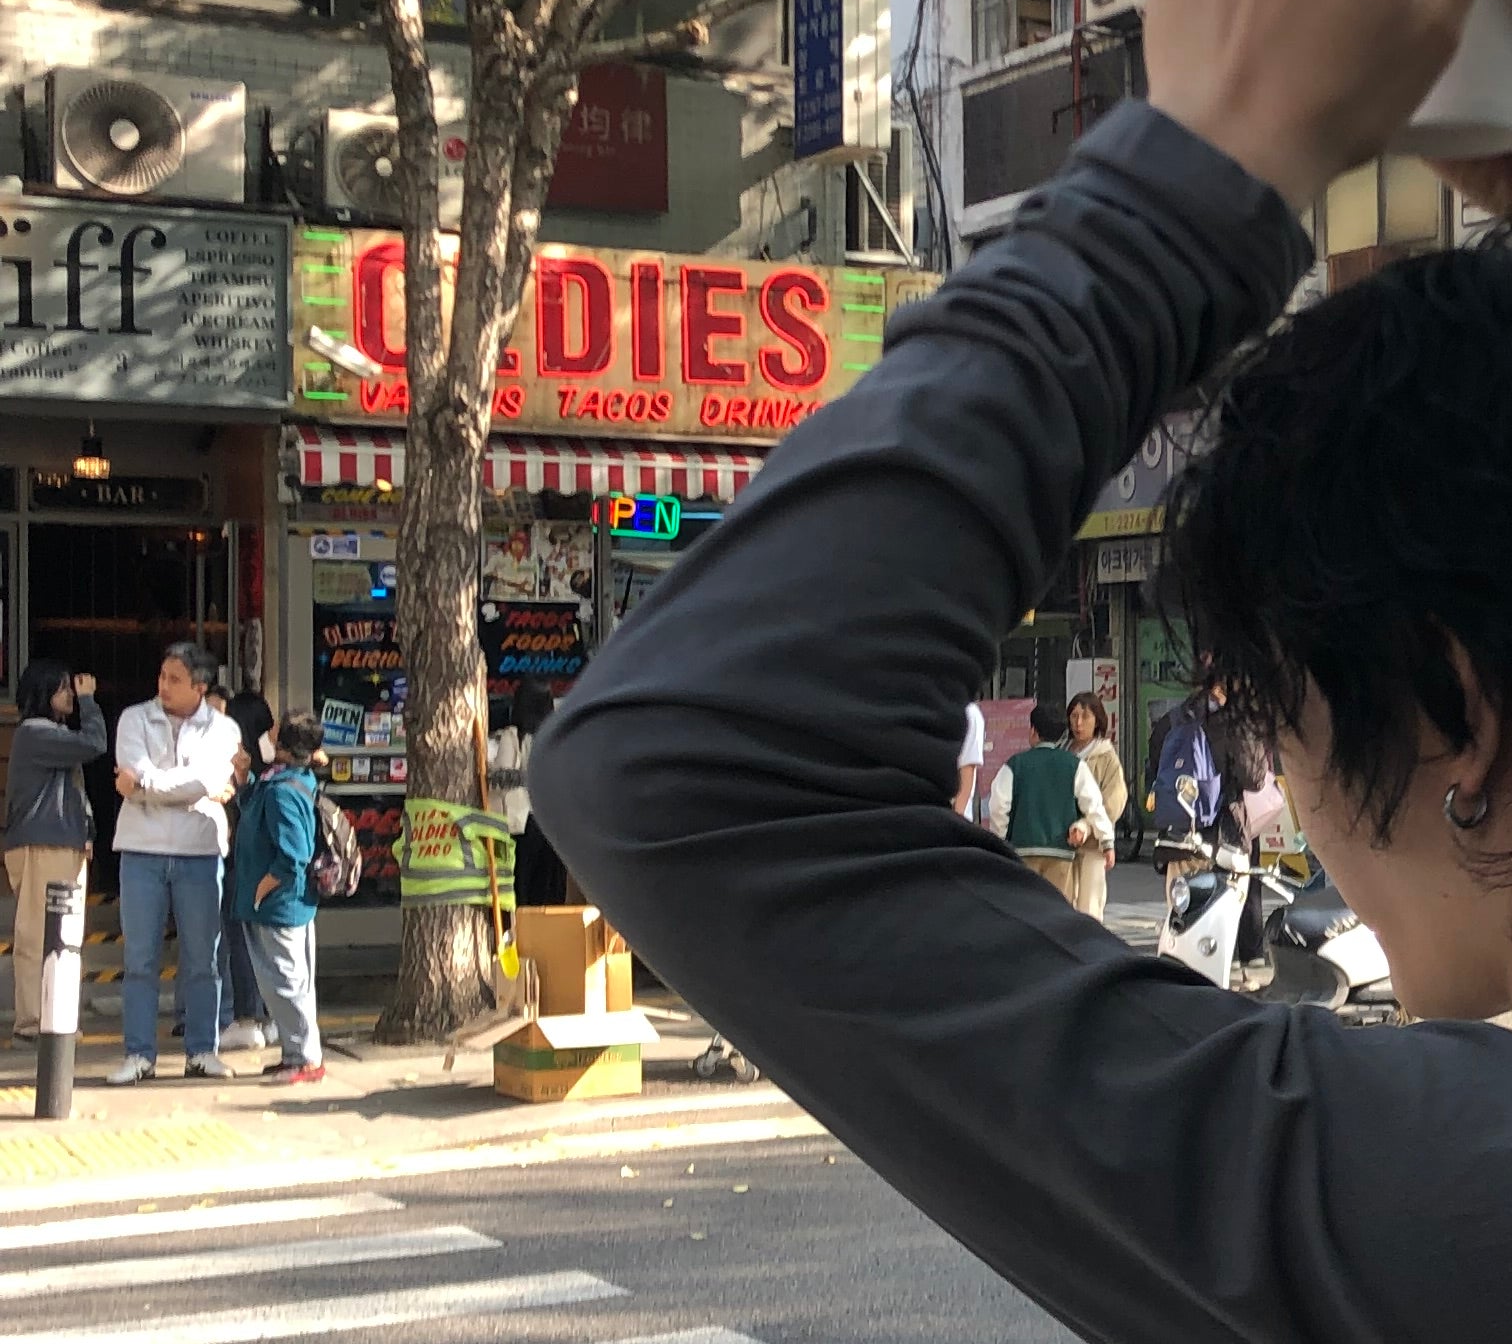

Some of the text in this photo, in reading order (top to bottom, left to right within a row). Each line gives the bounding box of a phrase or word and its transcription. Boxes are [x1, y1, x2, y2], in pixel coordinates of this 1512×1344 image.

[0, 219, 167, 337] iff
[558, 385, 673, 424] TACOS
[98, 484, 144, 504] BAR
[331, 649, 403, 671] DELICIO
[325, 703, 361, 726] OPEN
